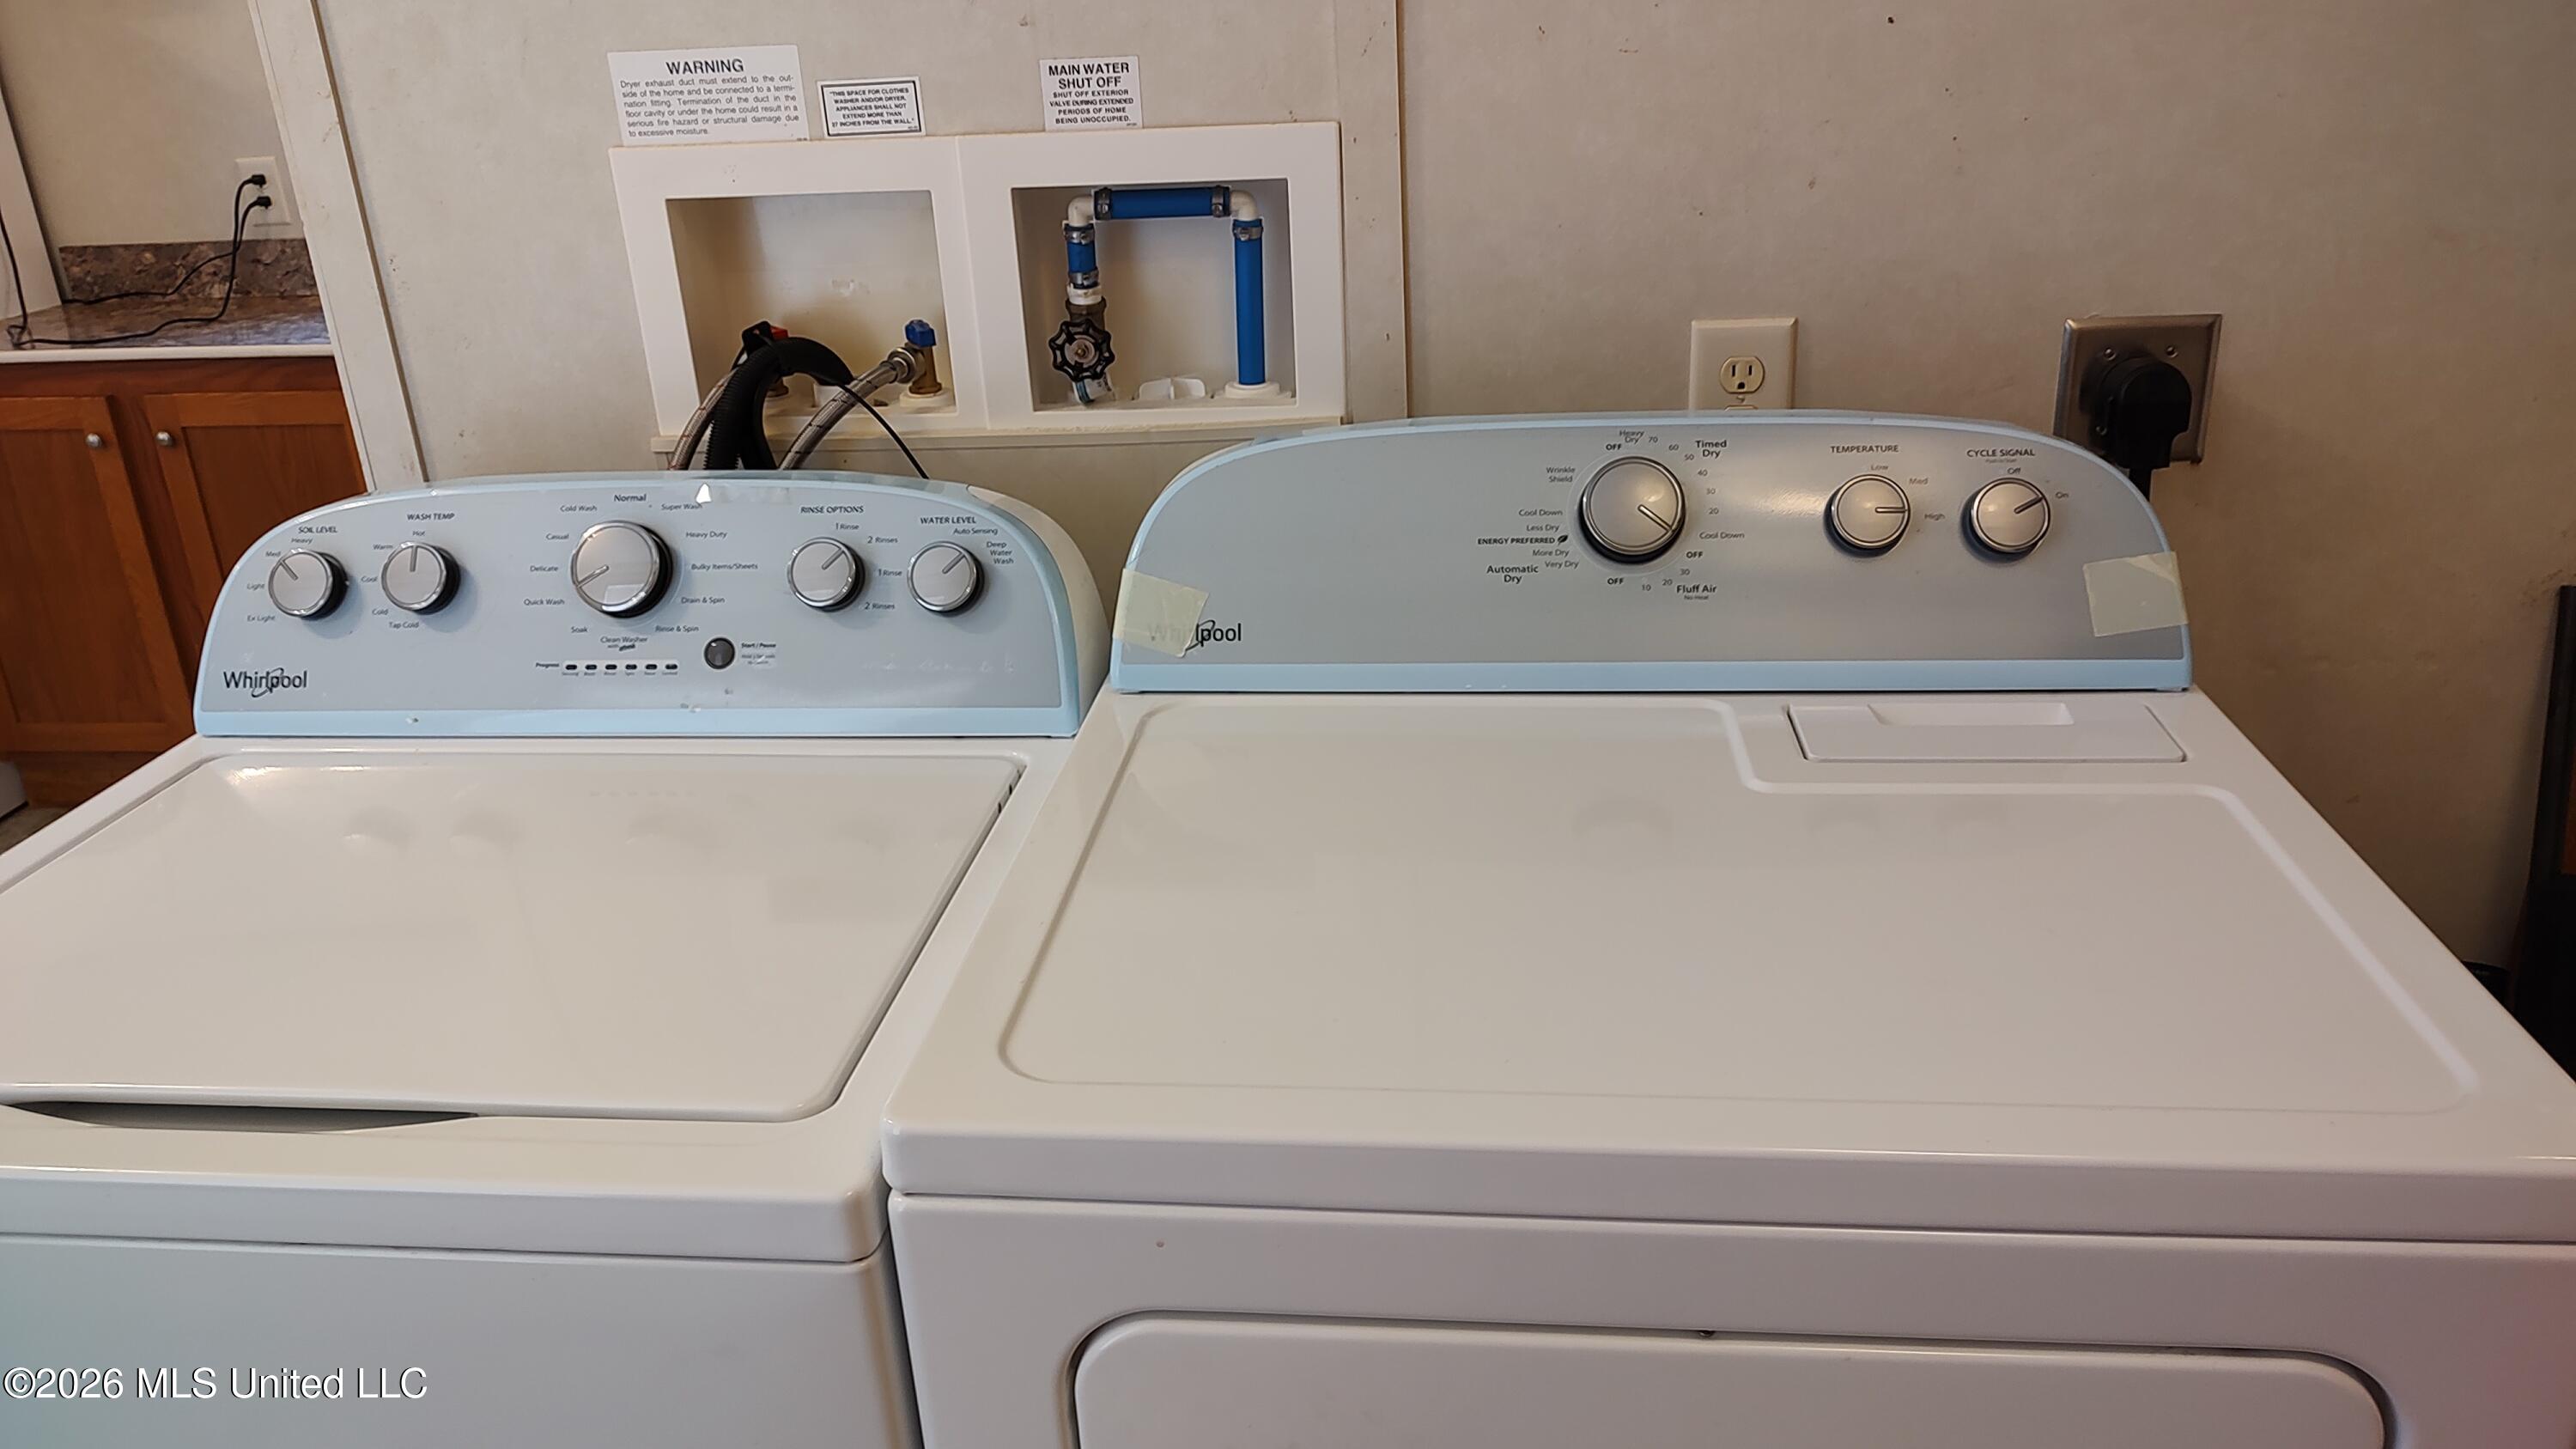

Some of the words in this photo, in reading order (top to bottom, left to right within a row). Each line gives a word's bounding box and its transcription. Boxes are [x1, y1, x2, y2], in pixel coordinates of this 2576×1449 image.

[665, 58, 744, 75] WARNING
[1048, 64, 1080, 76] MAIN
[1083, 62, 1130, 75] WATER
[620, 80, 641, 88] Dryer
[1058, 76, 1092, 89] SHUT
[1096, 76, 1121, 88] OFF
[713, 116, 748, 125] structural
[751, 115, 782, 124] damage
[1625, 435, 1639, 444] Dry
[1695, 440, 1728, 448] Timed
[1830, 444, 1899, 454] TEMPERATURE
[1966, 448, 1997, 458] CYCLE
[1999, 448, 2036, 457] SIGNAL
[1702, 449, 1722, 459] Dry
[1549, 475, 1573, 484] Shield
[613, 494, 647, 502] Normal
[560, 504, 577, 513] Cold
[579, 503, 598, 512] Wash
[660, 502, 682, 511] Super
[683, 502, 702, 510] Wash
[800, 506, 824, 514] RINSE
[826, 505, 865, 514] OPTIONS
[1518, 508, 1538, 517] Cool
[1539, 508, 1563, 517] Down
[1924, 513, 1946, 521] High
[920, 516, 950, 525] WATER
[951, 516, 976, 525] LEVEL
[953, 527, 970, 535] Auto
[971, 527, 998, 536] Sensing
[1545, 524, 1559, 533] Dry
[686, 531, 710, 540] Heavy
[710, 530, 728, 539] Duty
[1720, 531, 1745, 539] Down
[987, 541, 1006, 550] Deep
[1478, 537, 1510, 545] ENERGY
[1553, 549, 1570, 558] Dry
[530, 564, 559, 573] Delicate
[691, 563, 711, 571] Bulky
[712, 562, 758, 570] Items/Sheets
[1486, 564, 1539, 574] Automatic
[1545, 560, 1564, 569] Very
[1564, 560, 1579, 569] Dry
[1503, 574, 1522, 584] Dry
[1607, 577, 1625, 586] OFF
[246, 582, 264, 591] Light
[1642, 583, 1651, 592] 10
[1676, 584, 1700, 594] Fluff
[1702, 584, 1717, 593] Air
[524, 598, 544, 606] Quick
[708, 596, 725, 606] Spin
[683, 624, 699, 634] Spin
[1147, 619, 1242, 650] Whlpool
[622, 636, 648, 644] Washer
[222, 667, 307, 697] Whirlpool
